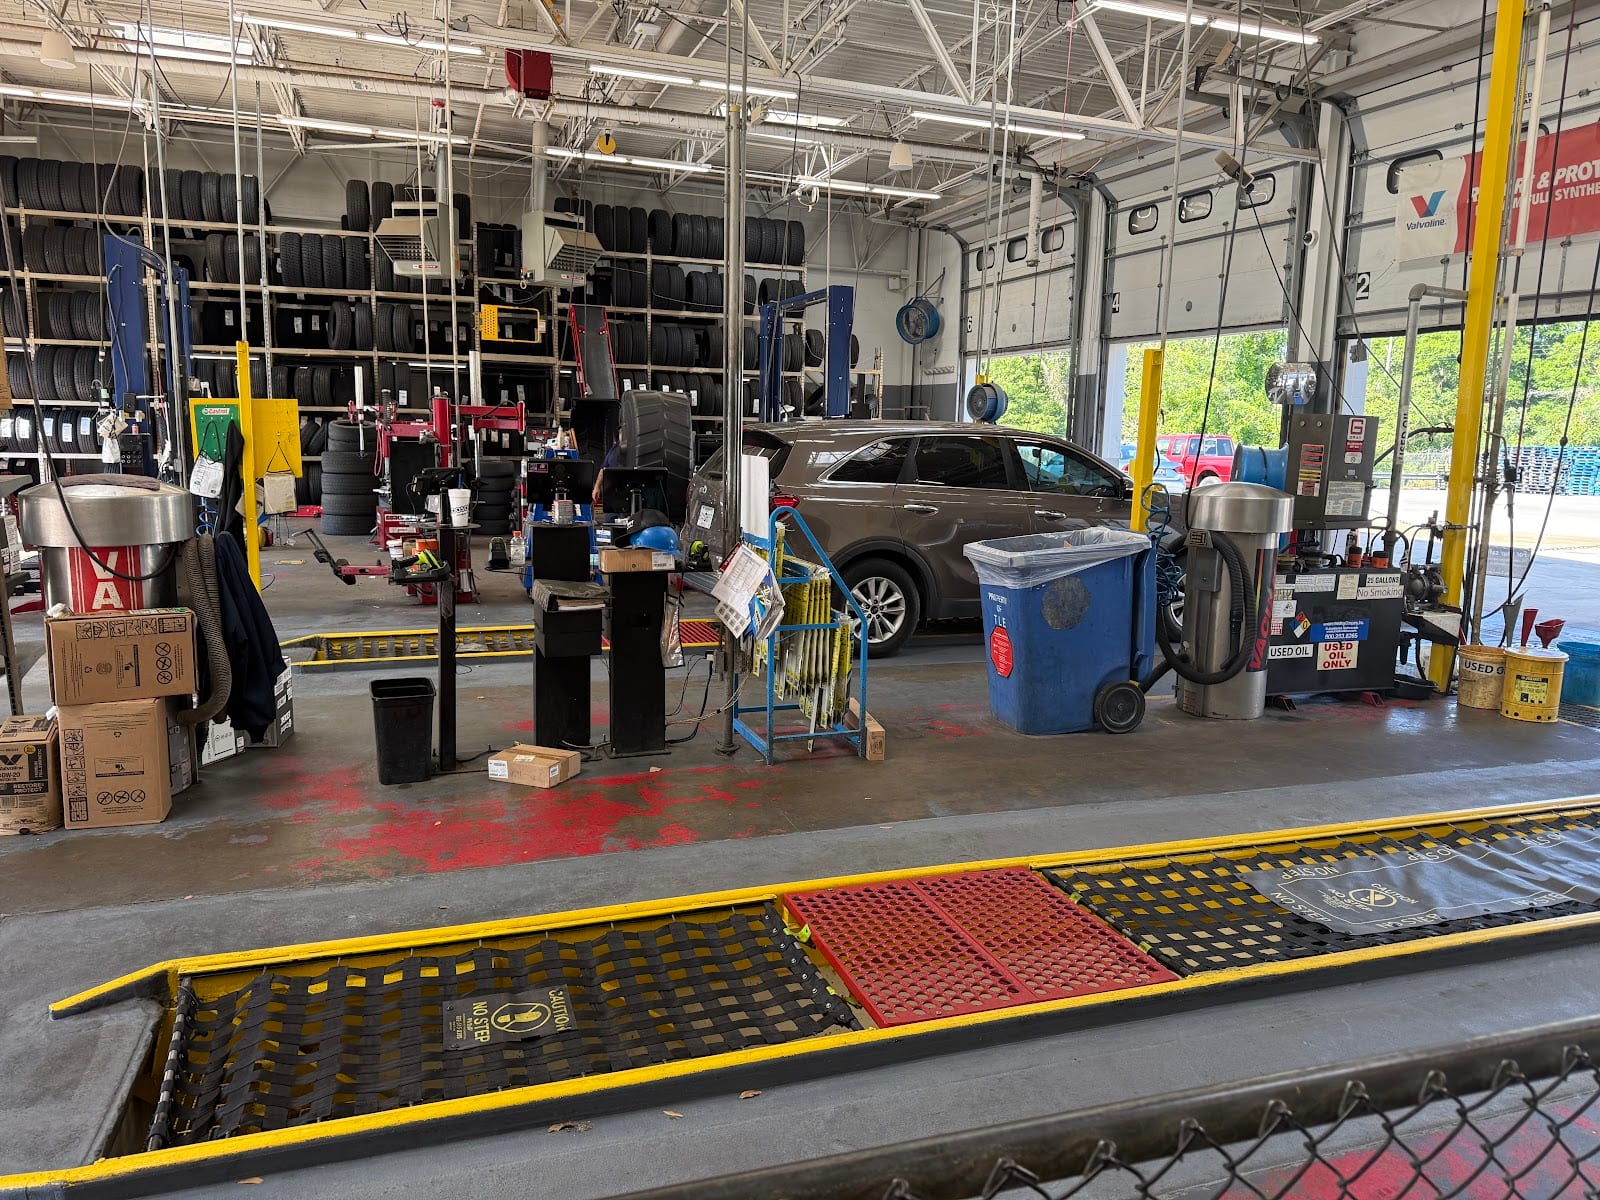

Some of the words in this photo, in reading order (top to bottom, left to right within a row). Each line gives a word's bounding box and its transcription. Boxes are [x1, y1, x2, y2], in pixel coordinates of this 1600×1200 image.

[1406, 218, 1446, 231] Valvoline
[1357, 273, 1370, 298] 2
[1112, 294, 1120, 312] 4
[1357, 588, 1369, 597] No
[1270, 647, 1293, 657] USED
[1295, 646, 1309, 656] OIL
[1324, 642, 1353, 651] USED
[1329, 651, 1347, 660] OIL
[1323, 659, 1352, 669] ONLY
[1464, 659, 1494, 674] USED
[1282, 867, 1316, 880] STEP
[1317, 865, 1340, 876] NO
[1371, 883, 1420, 905] CAUTION
[1270, 892, 1296, 905] NO
[1293, 904, 1333, 923] STEP
[1343, 897, 1374, 912] STEP
[1400, 913, 1439, 926] STEP
[472, 1001, 489, 1016] NO
[548, 988, 572, 1032] CAUTION
[473, 1017, 491, 1043] STEP
